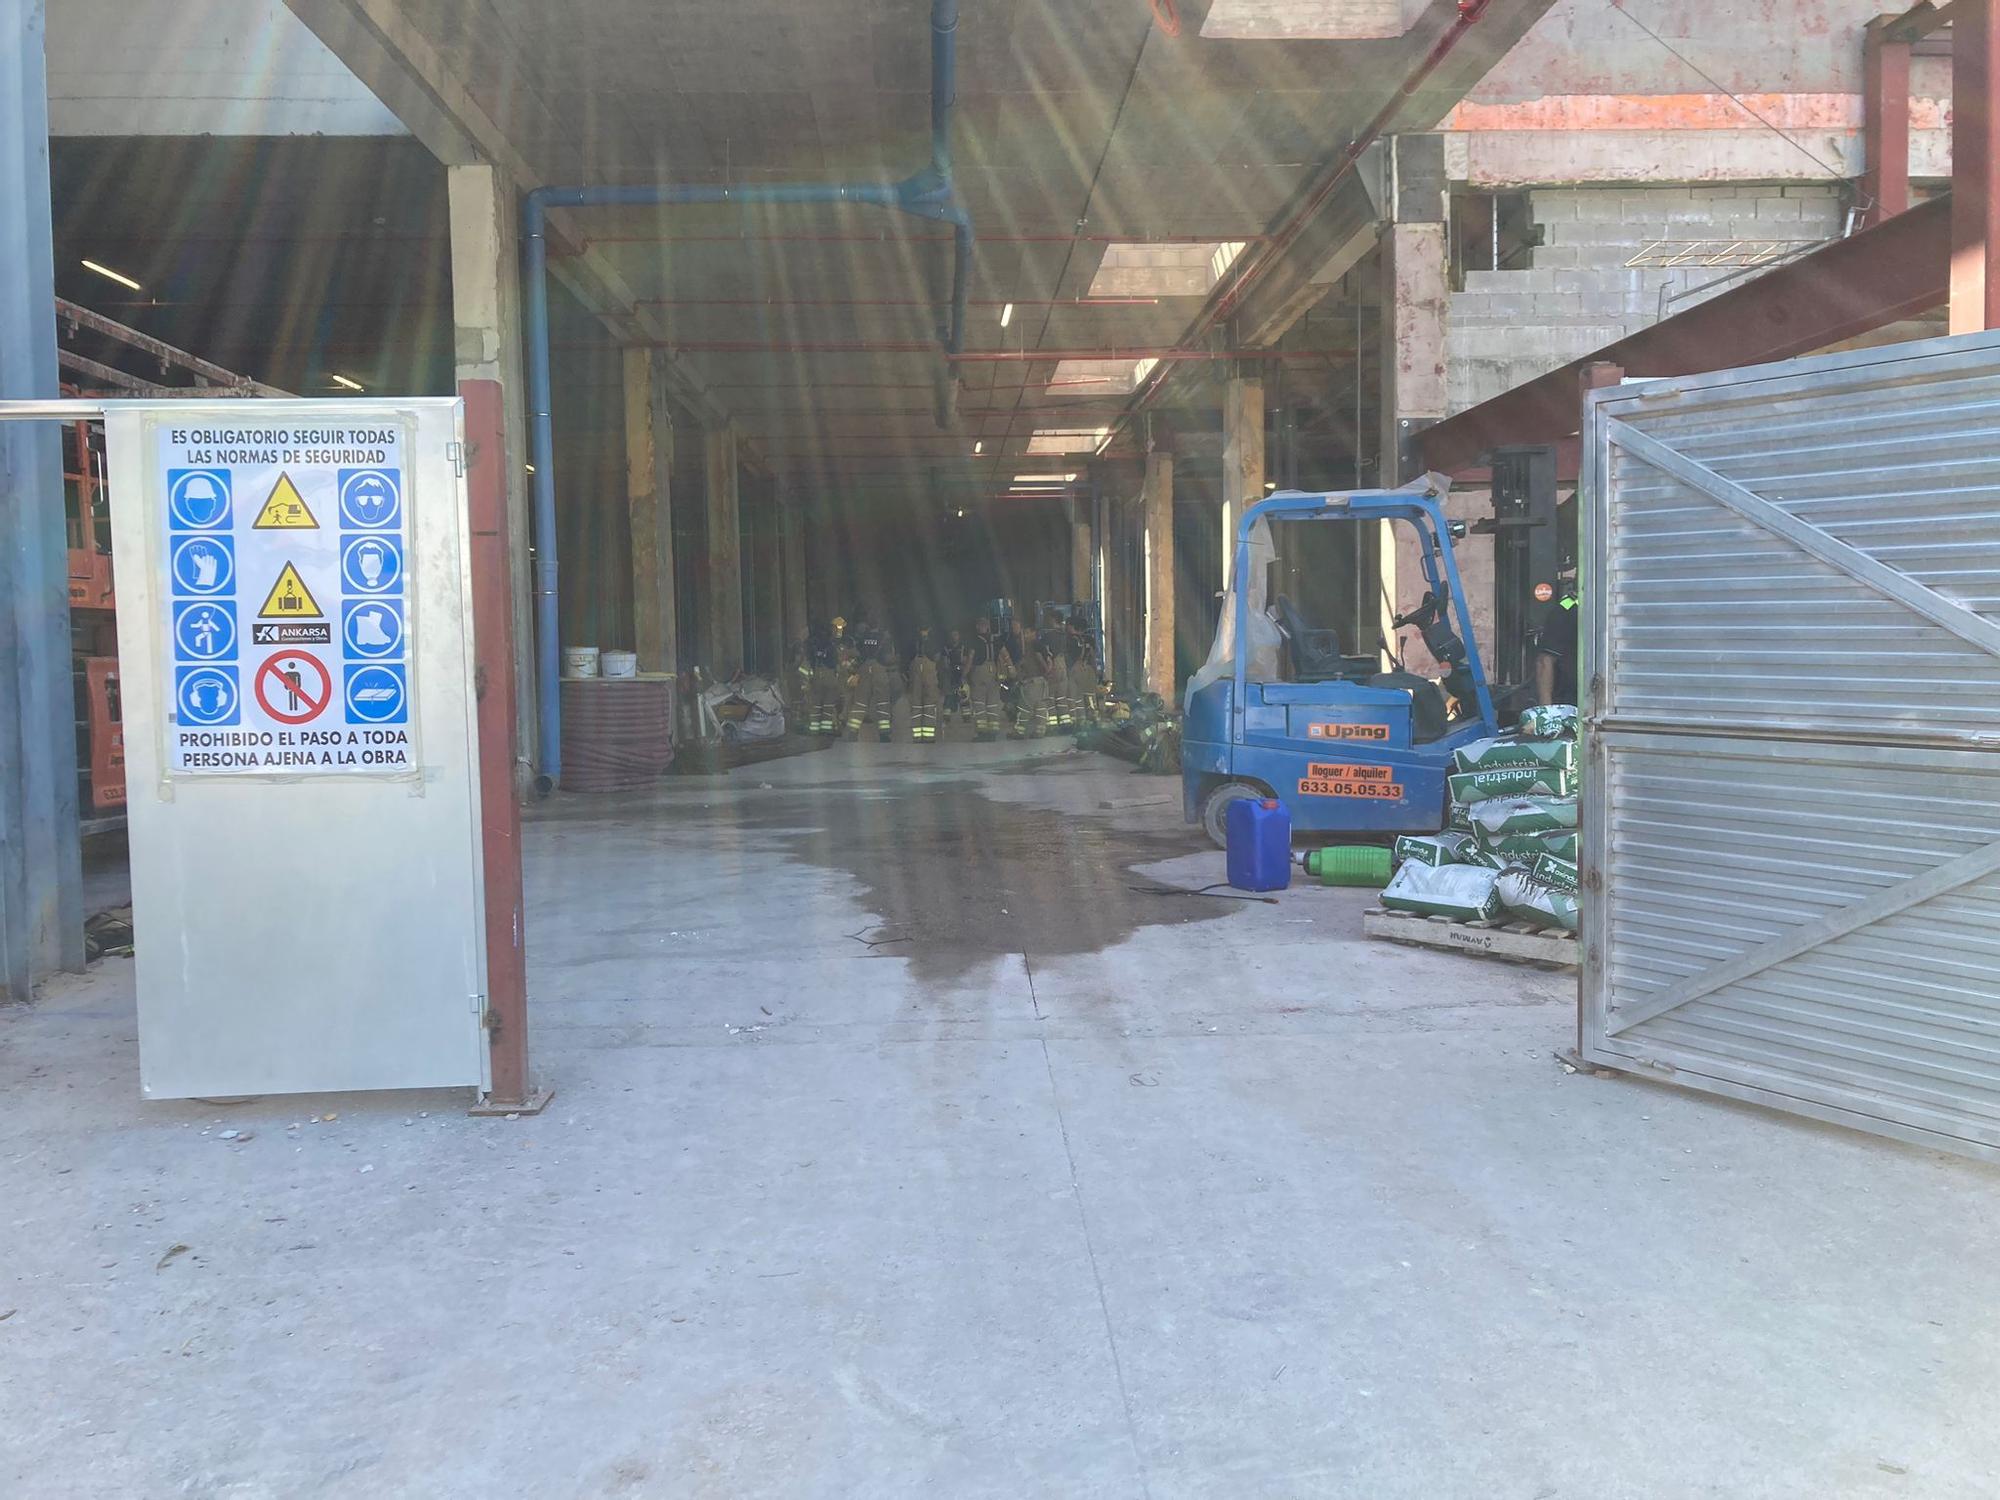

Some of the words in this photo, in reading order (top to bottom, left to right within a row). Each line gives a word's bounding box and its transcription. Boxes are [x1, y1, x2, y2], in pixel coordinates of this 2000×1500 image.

[171, 430, 187, 444] ES
[190, 430, 289, 444] OBLIGATORIO
[293, 430, 345, 444] SEGUIR
[348, 430, 395, 444] TODAS
[187, 450, 212, 464] LAS
[216, 450, 278, 464] NORMAS
[283, 449, 301, 463] DE
[305, 449, 386, 464] SEGURIDAD
[281, 628, 328, 637] ANKARSA
[179, 732, 273, 747] PROHIBIDO
[278, 731, 296, 746] EL
[300, 731, 342, 746] PASO
[346, 731, 359, 745] A
[363, 730, 408, 745] TODA
[1324, 725, 1387, 739] Uping
[183, 752, 259, 767] PERSONA
[263, 751, 317, 766] AJENA
[321, 751, 333, 765] A
[338, 750, 357, 764] LA
[364, 750, 407, 765] OBRA
[1353, 766, 1388, 780] alquiler
[1473, 770, 1538, 787] industrial
[1300, 781, 1401, 797] 633.05.05.33
